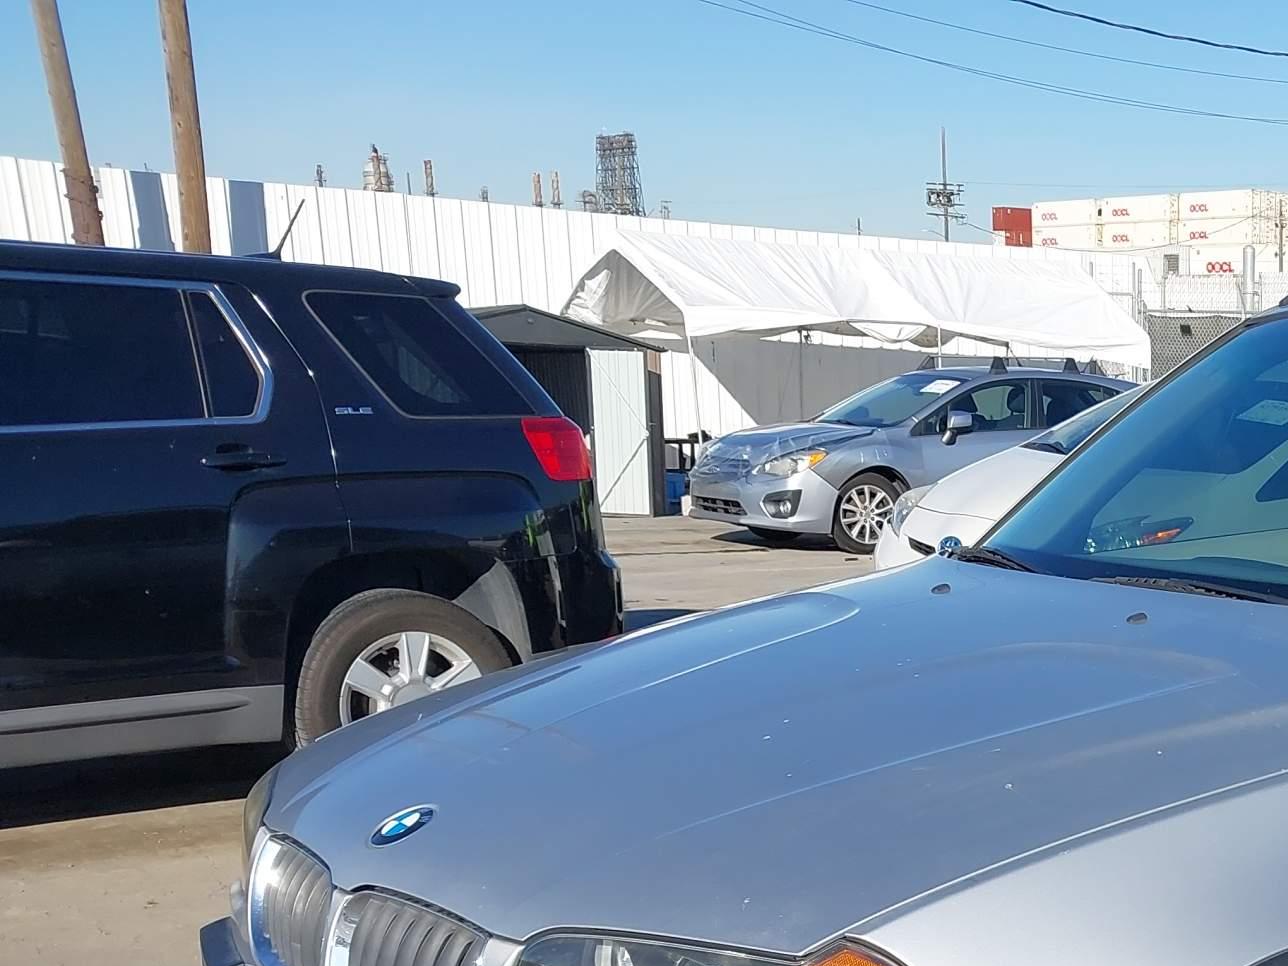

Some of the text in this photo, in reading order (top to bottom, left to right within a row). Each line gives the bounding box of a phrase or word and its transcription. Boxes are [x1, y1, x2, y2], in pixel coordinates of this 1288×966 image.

[1112, 208, 1130, 216] OOCL
[1189, 204, 1208, 212] OOCL
[1042, 213, 1058, 221] OOCL
[1112, 234, 1130, 242] OOCL
[1189, 231, 1208, 240] OOCL
[1042, 238, 1058, 246] OOCL
[1206, 261, 1234, 273] OOCL
